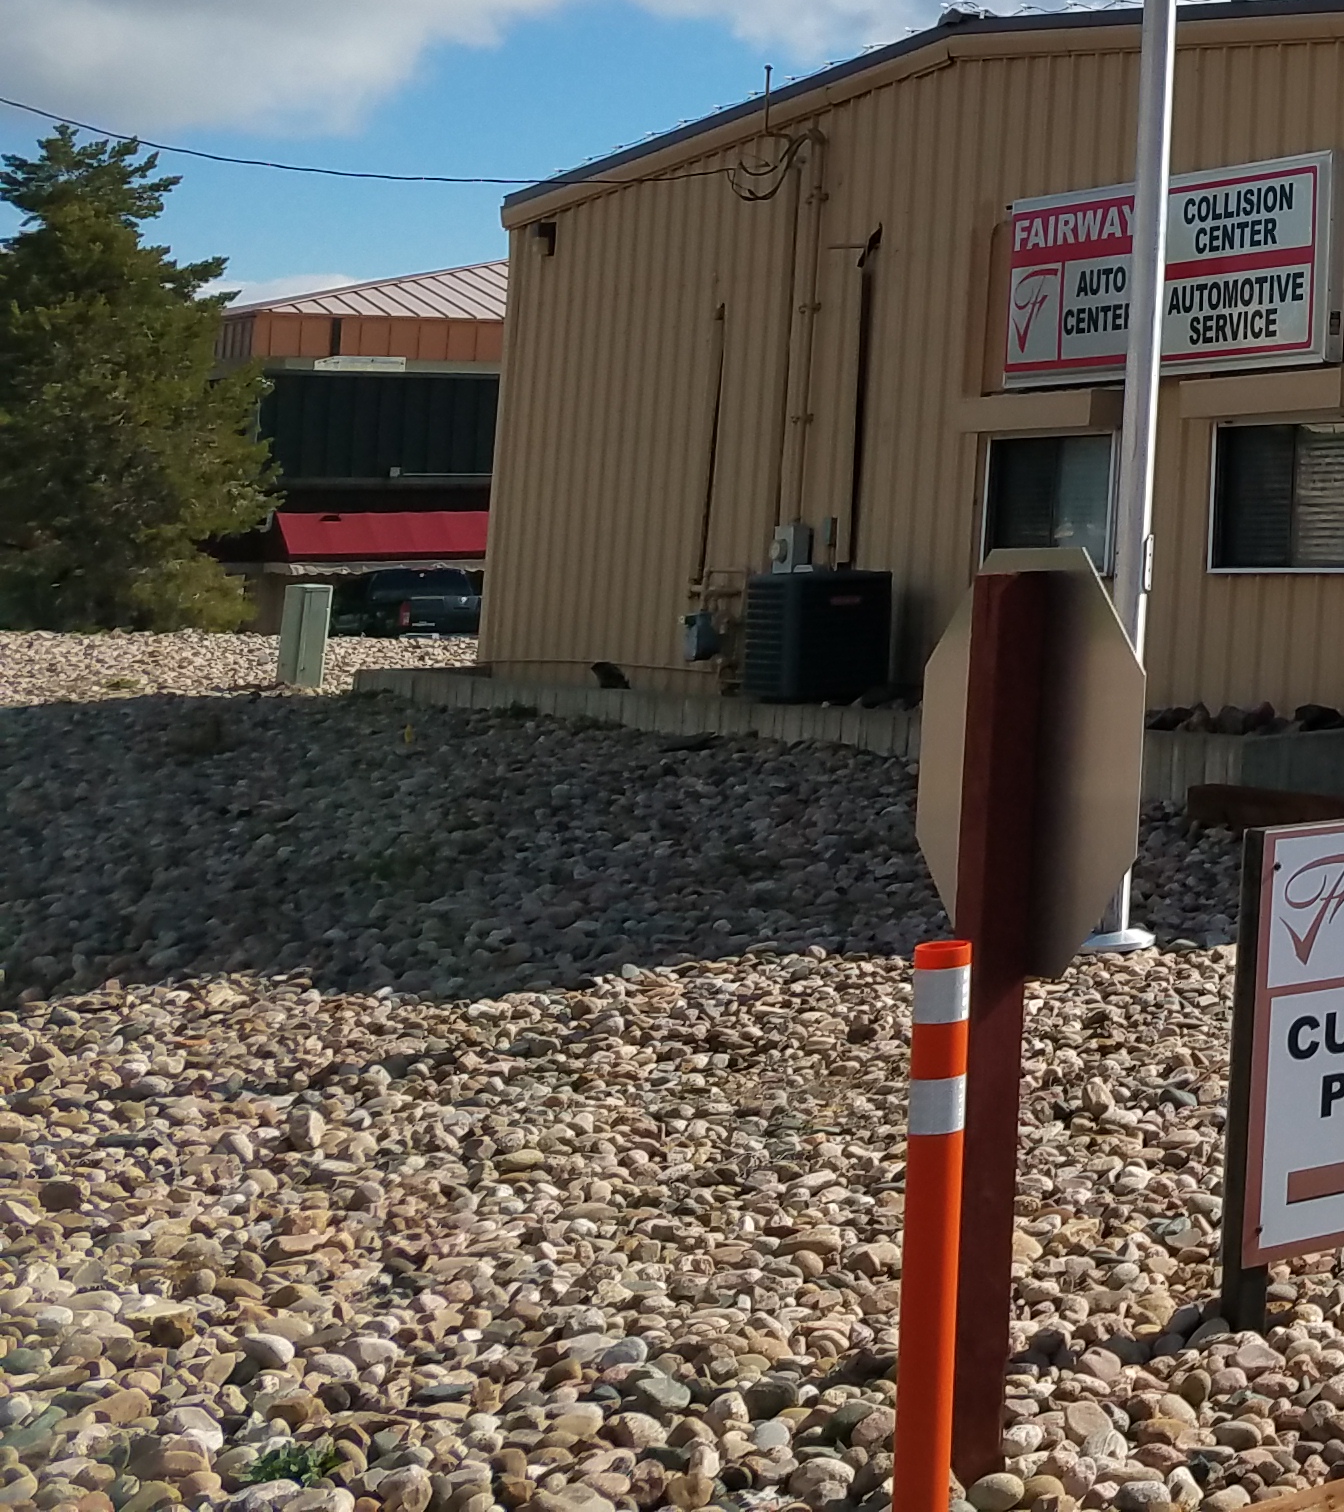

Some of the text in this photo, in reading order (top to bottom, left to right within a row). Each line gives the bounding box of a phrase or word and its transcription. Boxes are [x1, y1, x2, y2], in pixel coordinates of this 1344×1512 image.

[1183, 182, 1294, 225] COLLISION
[1013, 204, 1135, 252] FAIRWAY
[1194, 217, 1278, 255] CENTER
[1075, 265, 1127, 298] AUTO
[1167, 271, 1305, 316] AUTOMOTIVE
[1188, 307, 1279, 346] SERVICE
